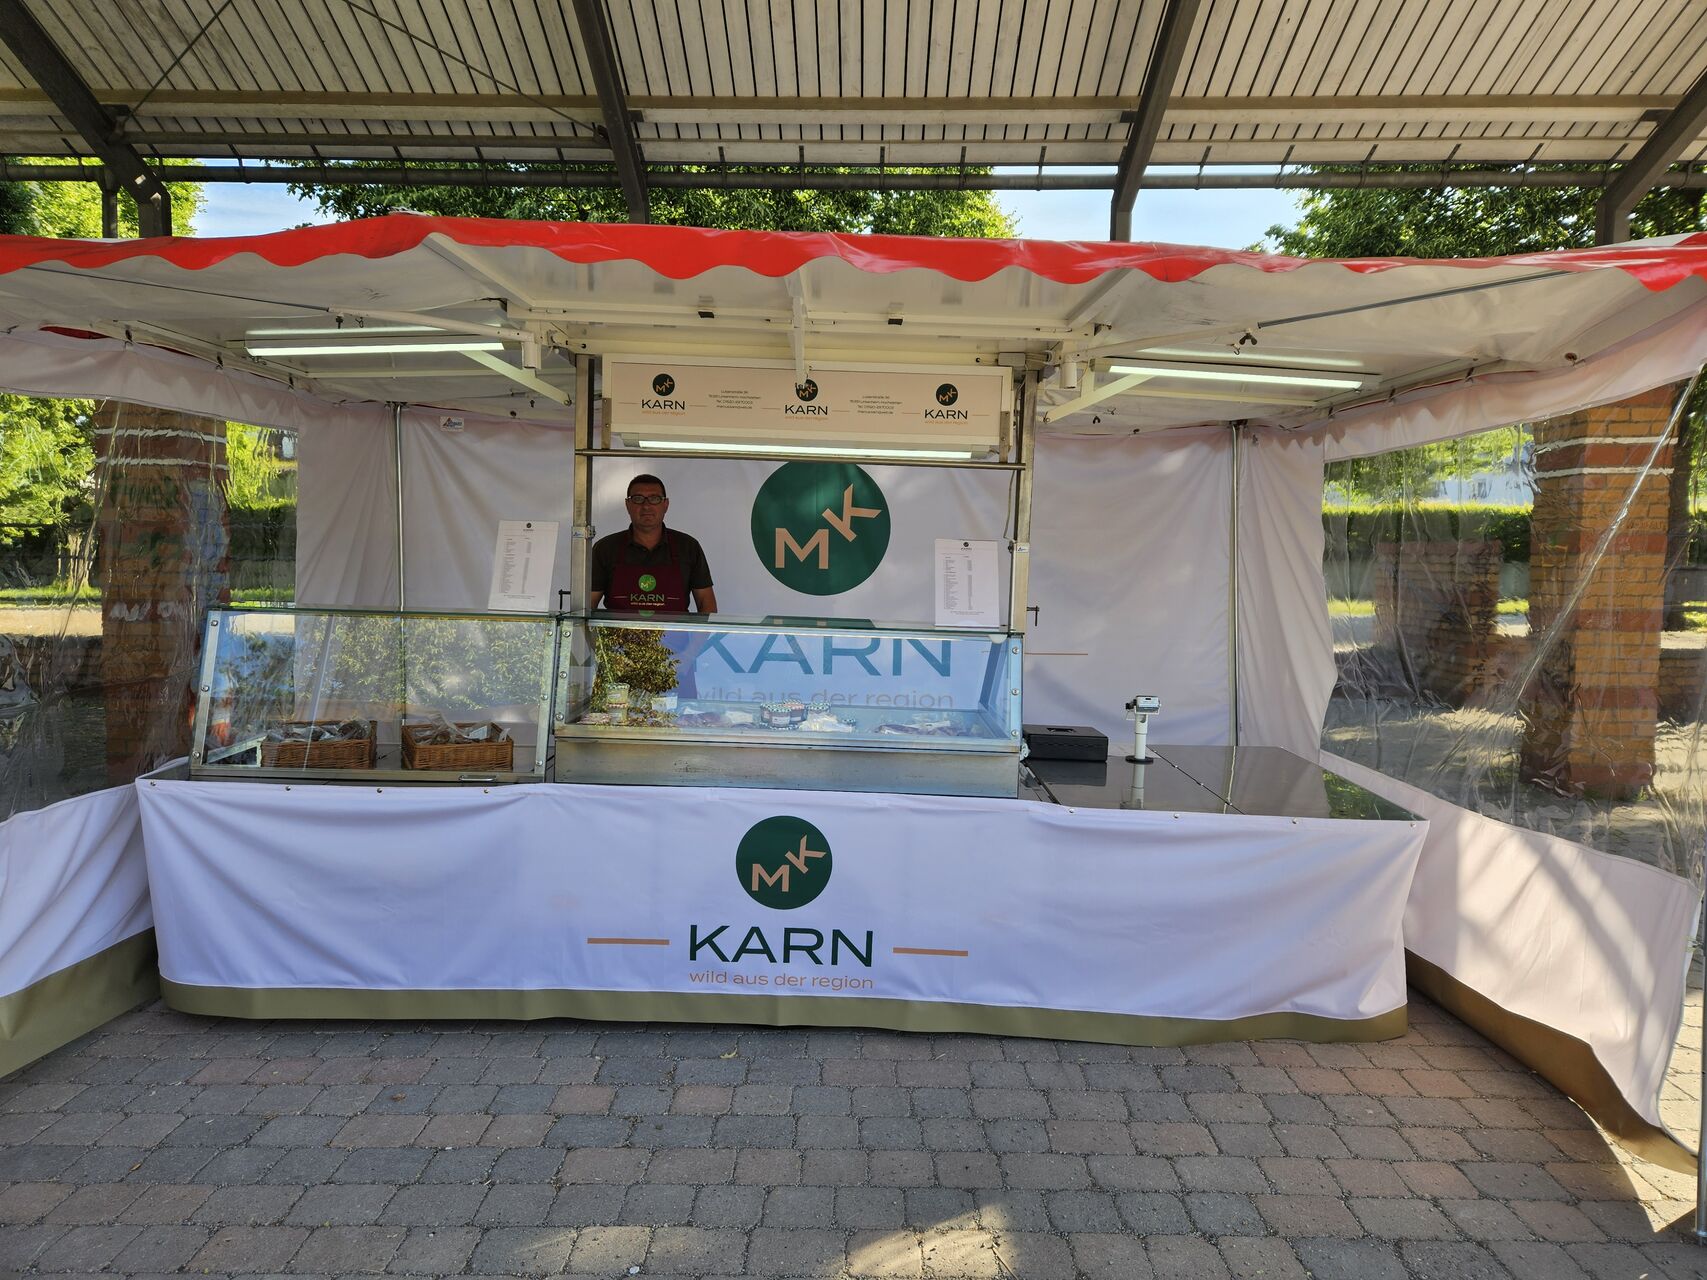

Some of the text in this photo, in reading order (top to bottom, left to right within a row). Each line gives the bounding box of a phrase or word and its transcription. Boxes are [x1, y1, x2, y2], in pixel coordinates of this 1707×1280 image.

[655, 378, 673, 392] MK
[938, 388, 957, 402] MK
[641, 399, 685, 410] KARN
[784, 404, 828, 415] KARN
[924, 409, 968, 420] KARN
[775, 483, 882, 569] MK
[630, 593, 665, 602] KARN
[751, 834, 827, 893] MK
[689, 924, 874, 968] KARN
[689, 970, 873, 991] wild aus der region
